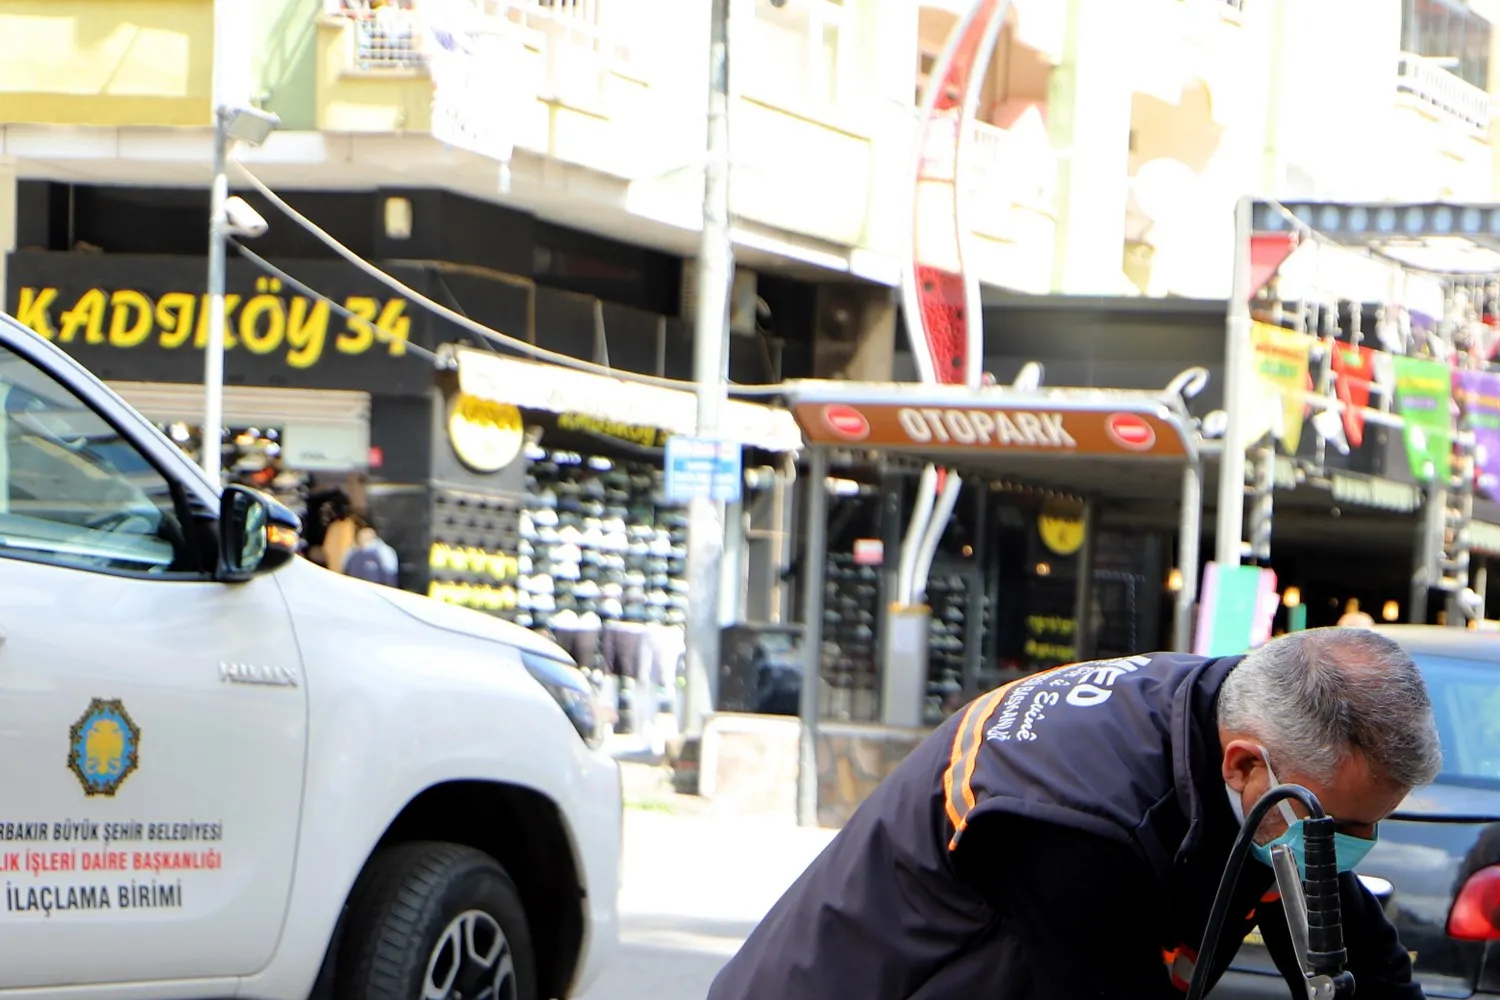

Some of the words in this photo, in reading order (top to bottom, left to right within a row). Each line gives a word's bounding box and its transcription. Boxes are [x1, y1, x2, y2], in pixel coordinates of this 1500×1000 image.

[336, 296, 411, 355] 34
[898, 407, 1077, 447] OTOPARK
[218, 661, 299, 688] HILUX
[53, 819, 99, 841] BÜYÜK
[103, 819, 143, 845] ŞEHİR
[148, 819, 223, 841] BELEDİYESİ
[26, 849, 75, 877] İŞLERİ
[82, 848, 128, 871] DAİRE
[133, 848, 222, 876] BAŞKANLIĞI
[7, 881, 111, 917] İLAÇLAMA
[118, 879, 182, 909] BİRİMİ
